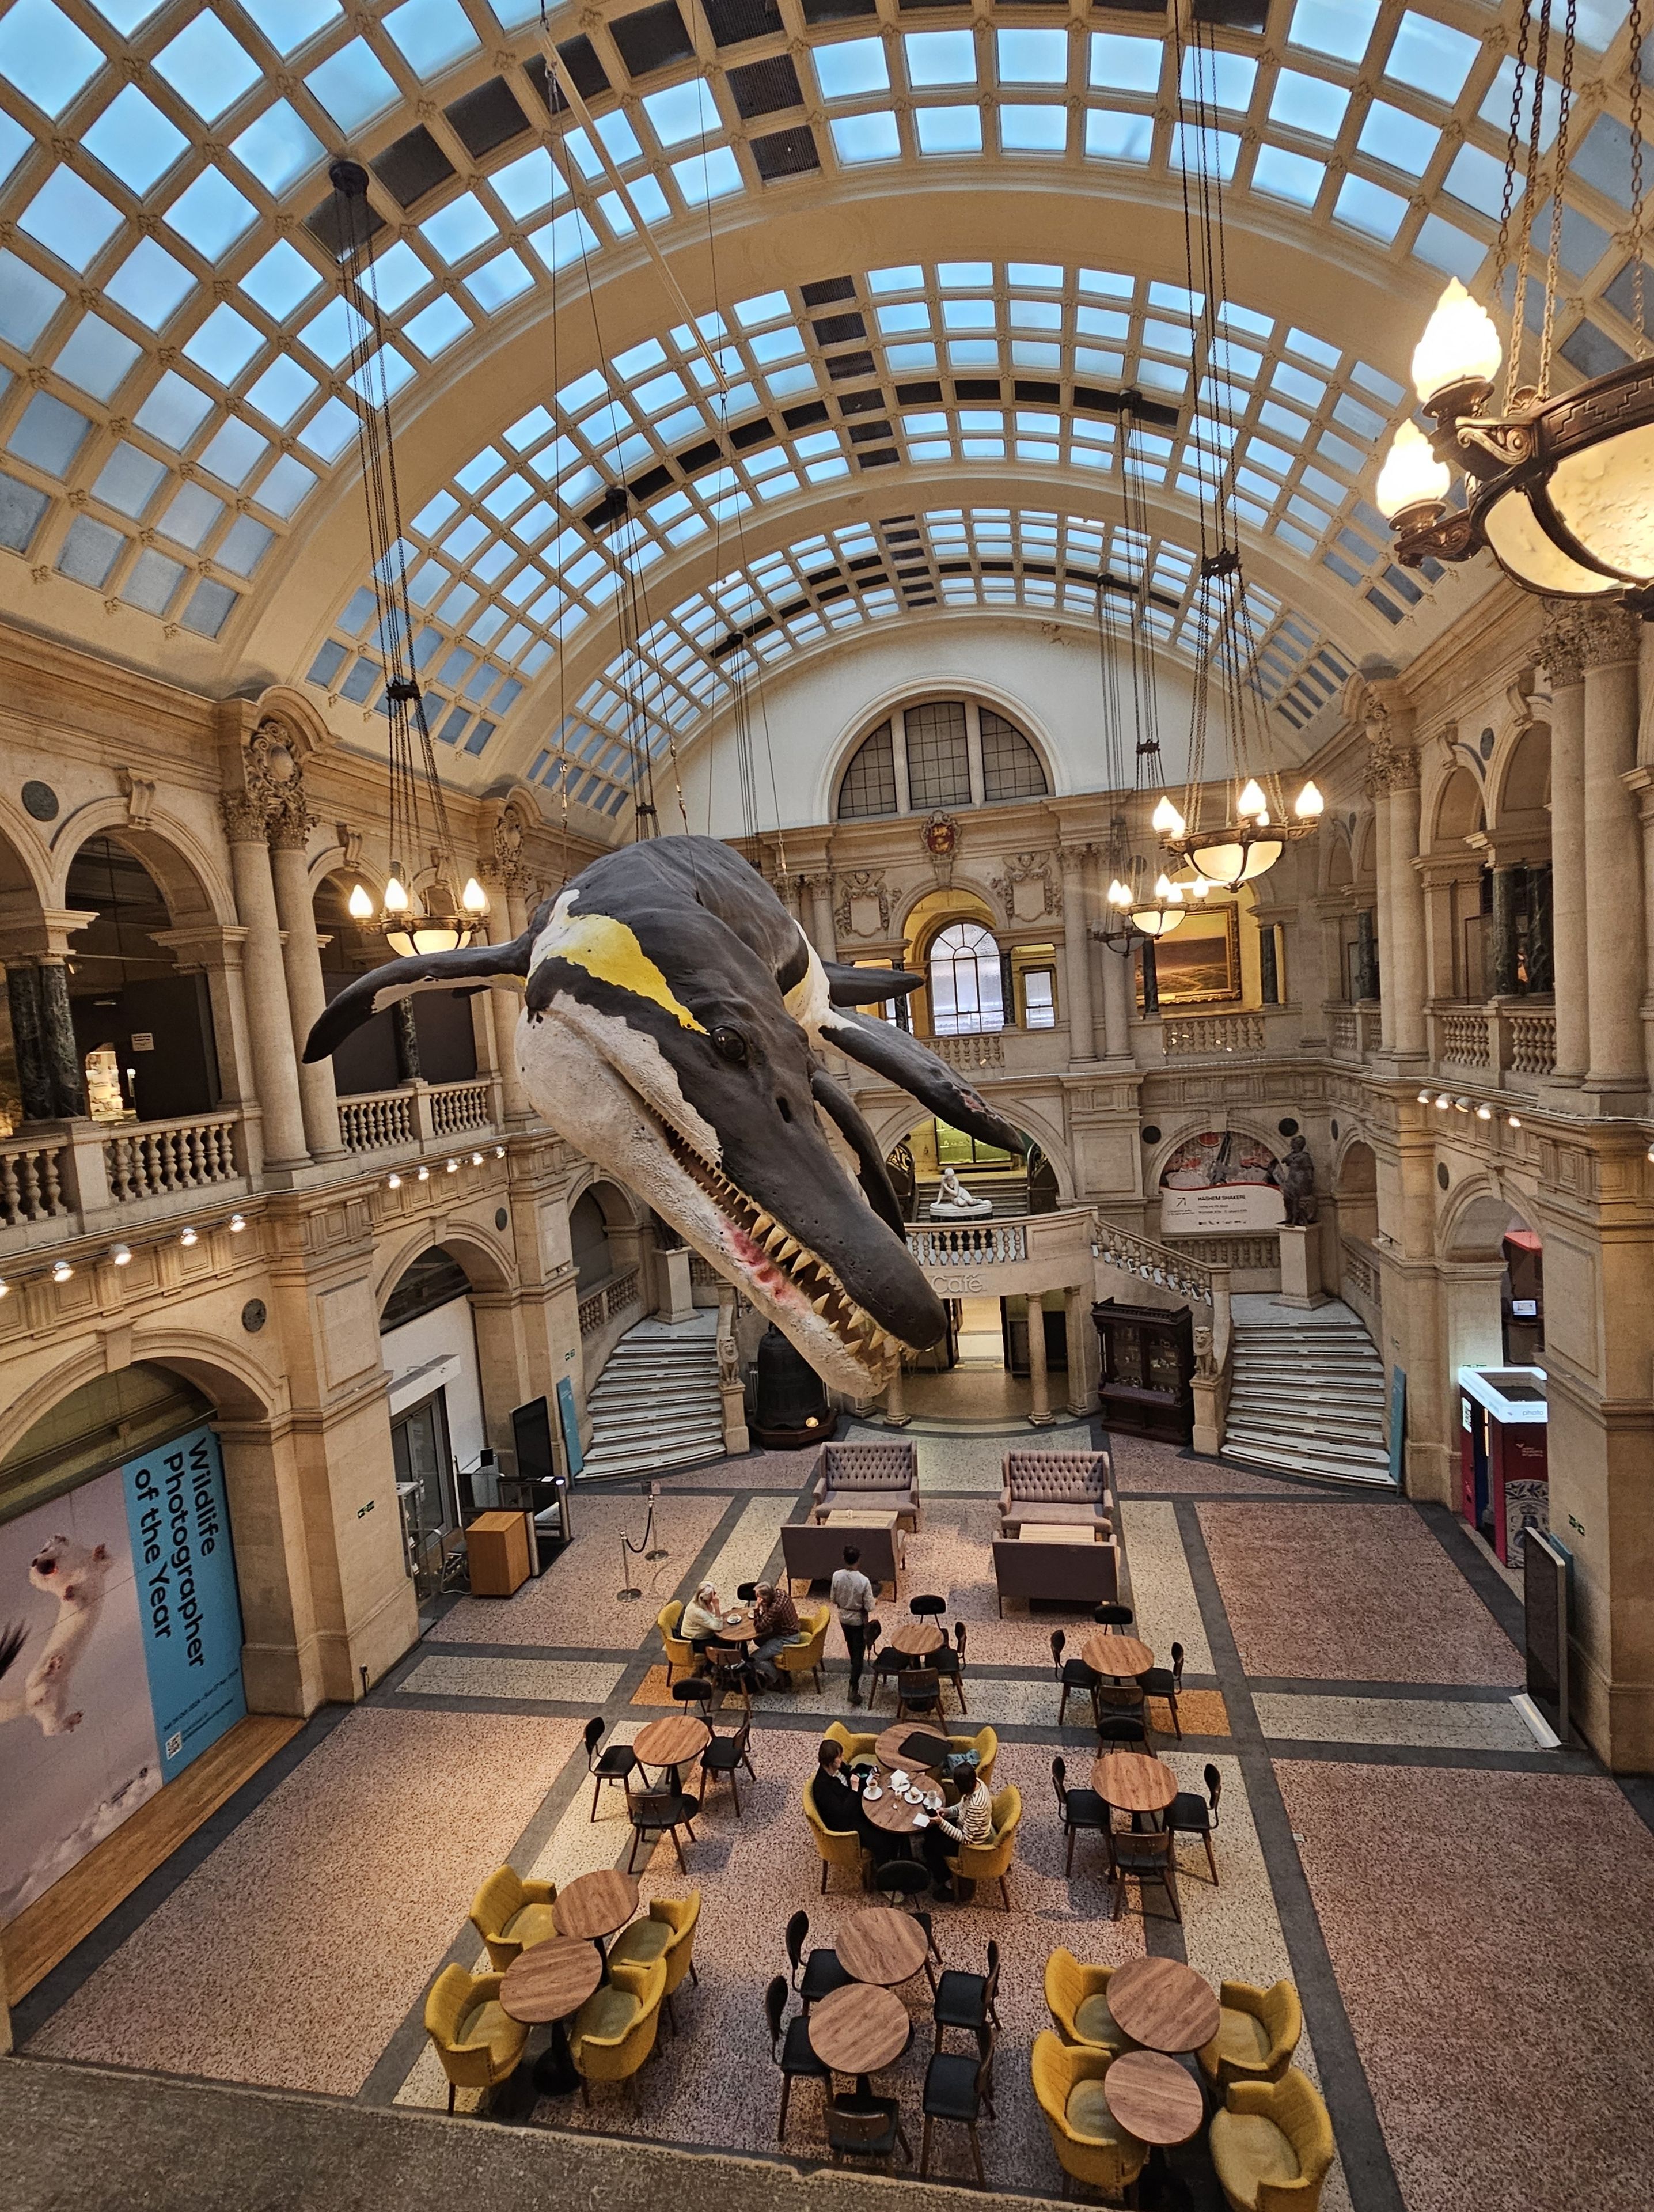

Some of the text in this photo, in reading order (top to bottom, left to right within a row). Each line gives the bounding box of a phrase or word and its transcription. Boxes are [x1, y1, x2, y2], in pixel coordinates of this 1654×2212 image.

[932, 1272, 982, 1293] Café
[135, 1469, 172, 1639] of the Year
[164, 1451, 204, 1668] Photographer
[189, 1437, 219, 1557] Wildlife
